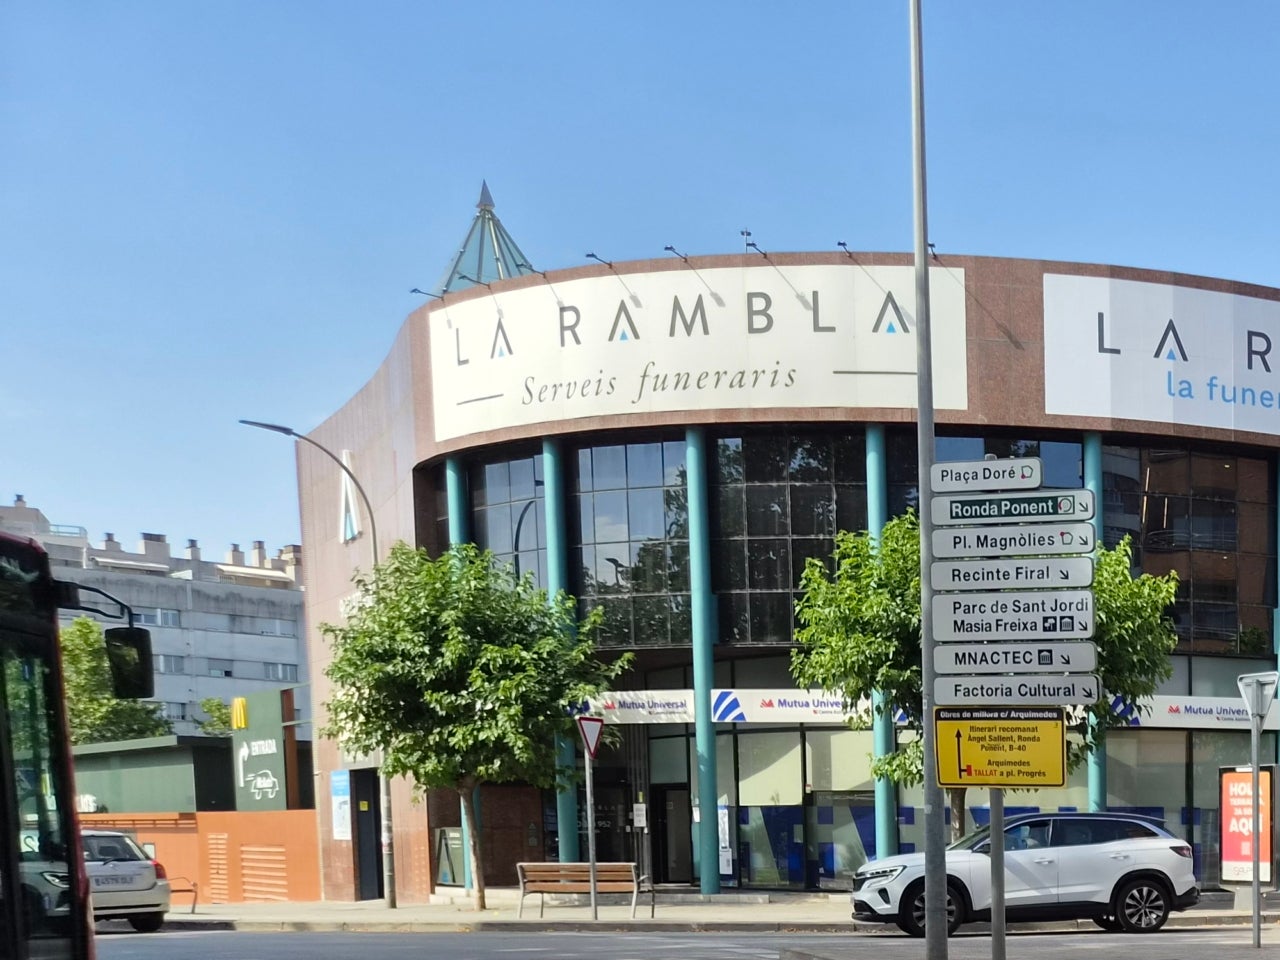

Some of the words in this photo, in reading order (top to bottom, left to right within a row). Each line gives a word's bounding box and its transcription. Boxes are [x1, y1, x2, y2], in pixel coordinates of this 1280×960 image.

[456, 317, 514, 366] LA
[559, 290, 910, 348] RAMBLA
[1097, 312, 1189, 362] LA
[522, 370, 617, 405] Serveis
[632, 361, 797, 404] funeraris
[1167, 371, 1194, 400] la
[941, 469, 978, 484] Plaça
[983, 466, 1016, 480] Doré
[951, 501, 998, 518] Ronda
[1001, 499, 1054, 516] Ponent
[953, 536, 972, 549] Pl.
[976, 532, 1055, 550] Magnòlies
[952, 568, 1010, 582] Recinte
[1015, 566, 1050, 580] Firal
[953, 601, 986, 614] Parc
[991, 600, 1008, 614] de
[1012, 599, 1046, 613] Sant
[1050, 598, 1088, 612] Jordi
[953, 619, 992, 633] Masia
[996, 618, 1037, 632] Freixa
[954, 651, 1033, 665] MNACTEC
[954, 683, 1012, 697] Factoria
[1018, 683, 1075, 697] Cultural
[618, 700, 645, 710] Mutua
[647, 699, 687, 710] Universal
[778, 699, 810, 708] Mutua
[1184, 705, 1213, 714] Mutua
[969, 725, 997, 733] Itinerari
[973, 769, 998, 777] TALLAT
